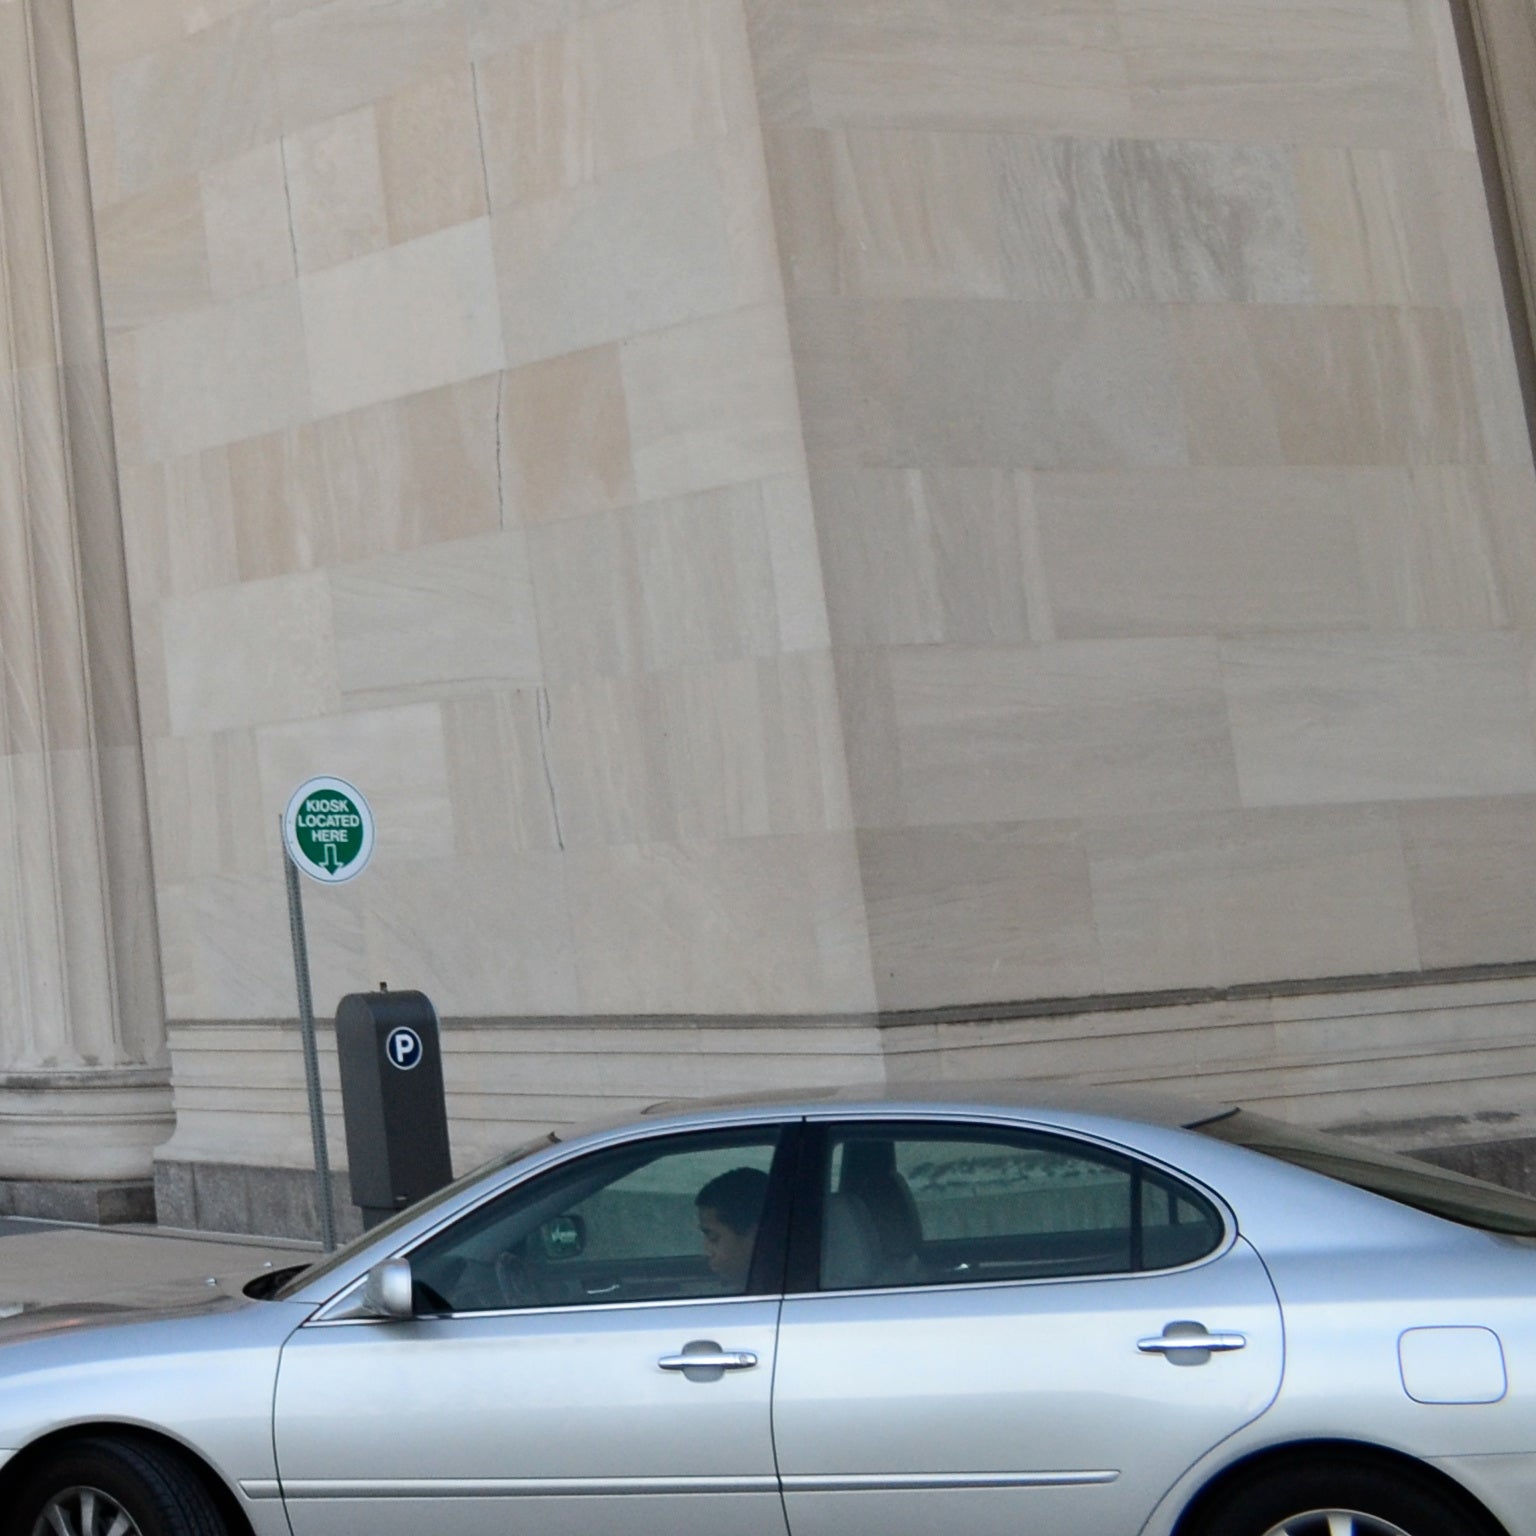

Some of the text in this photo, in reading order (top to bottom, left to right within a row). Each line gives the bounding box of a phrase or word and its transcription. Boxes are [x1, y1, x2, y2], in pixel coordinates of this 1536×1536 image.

[306, 799, 350, 813] KIOSK
[298, 814, 360, 827] LOCATED
[311, 829, 349, 843] HERE
[395, 1034, 414, 1062] P
